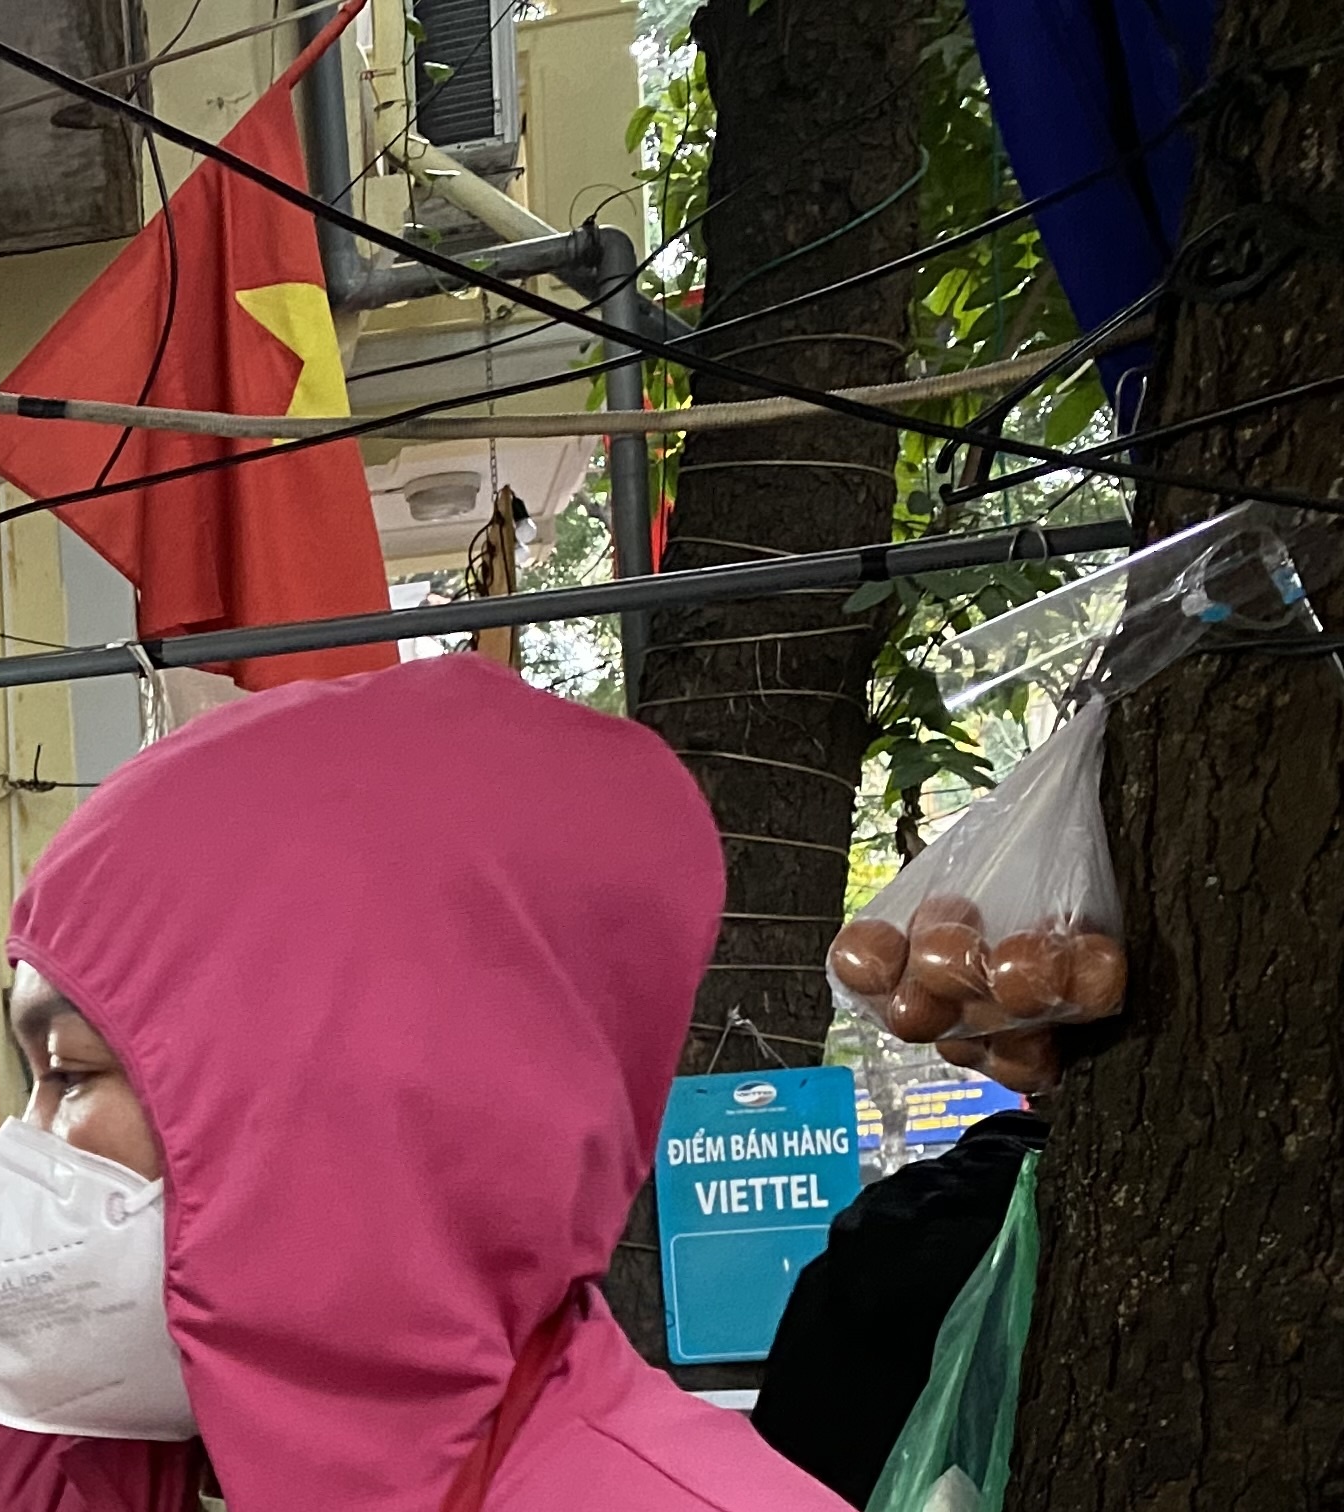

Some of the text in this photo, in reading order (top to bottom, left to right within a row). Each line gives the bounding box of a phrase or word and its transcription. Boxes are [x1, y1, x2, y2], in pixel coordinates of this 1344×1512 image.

[668, 1128, 725, 1166] ĐIỂM
[731, 1128, 774, 1161] BÁN
[783, 1124, 849, 1157] HÀNG
[695, 1174, 829, 1216] VIETTEL
